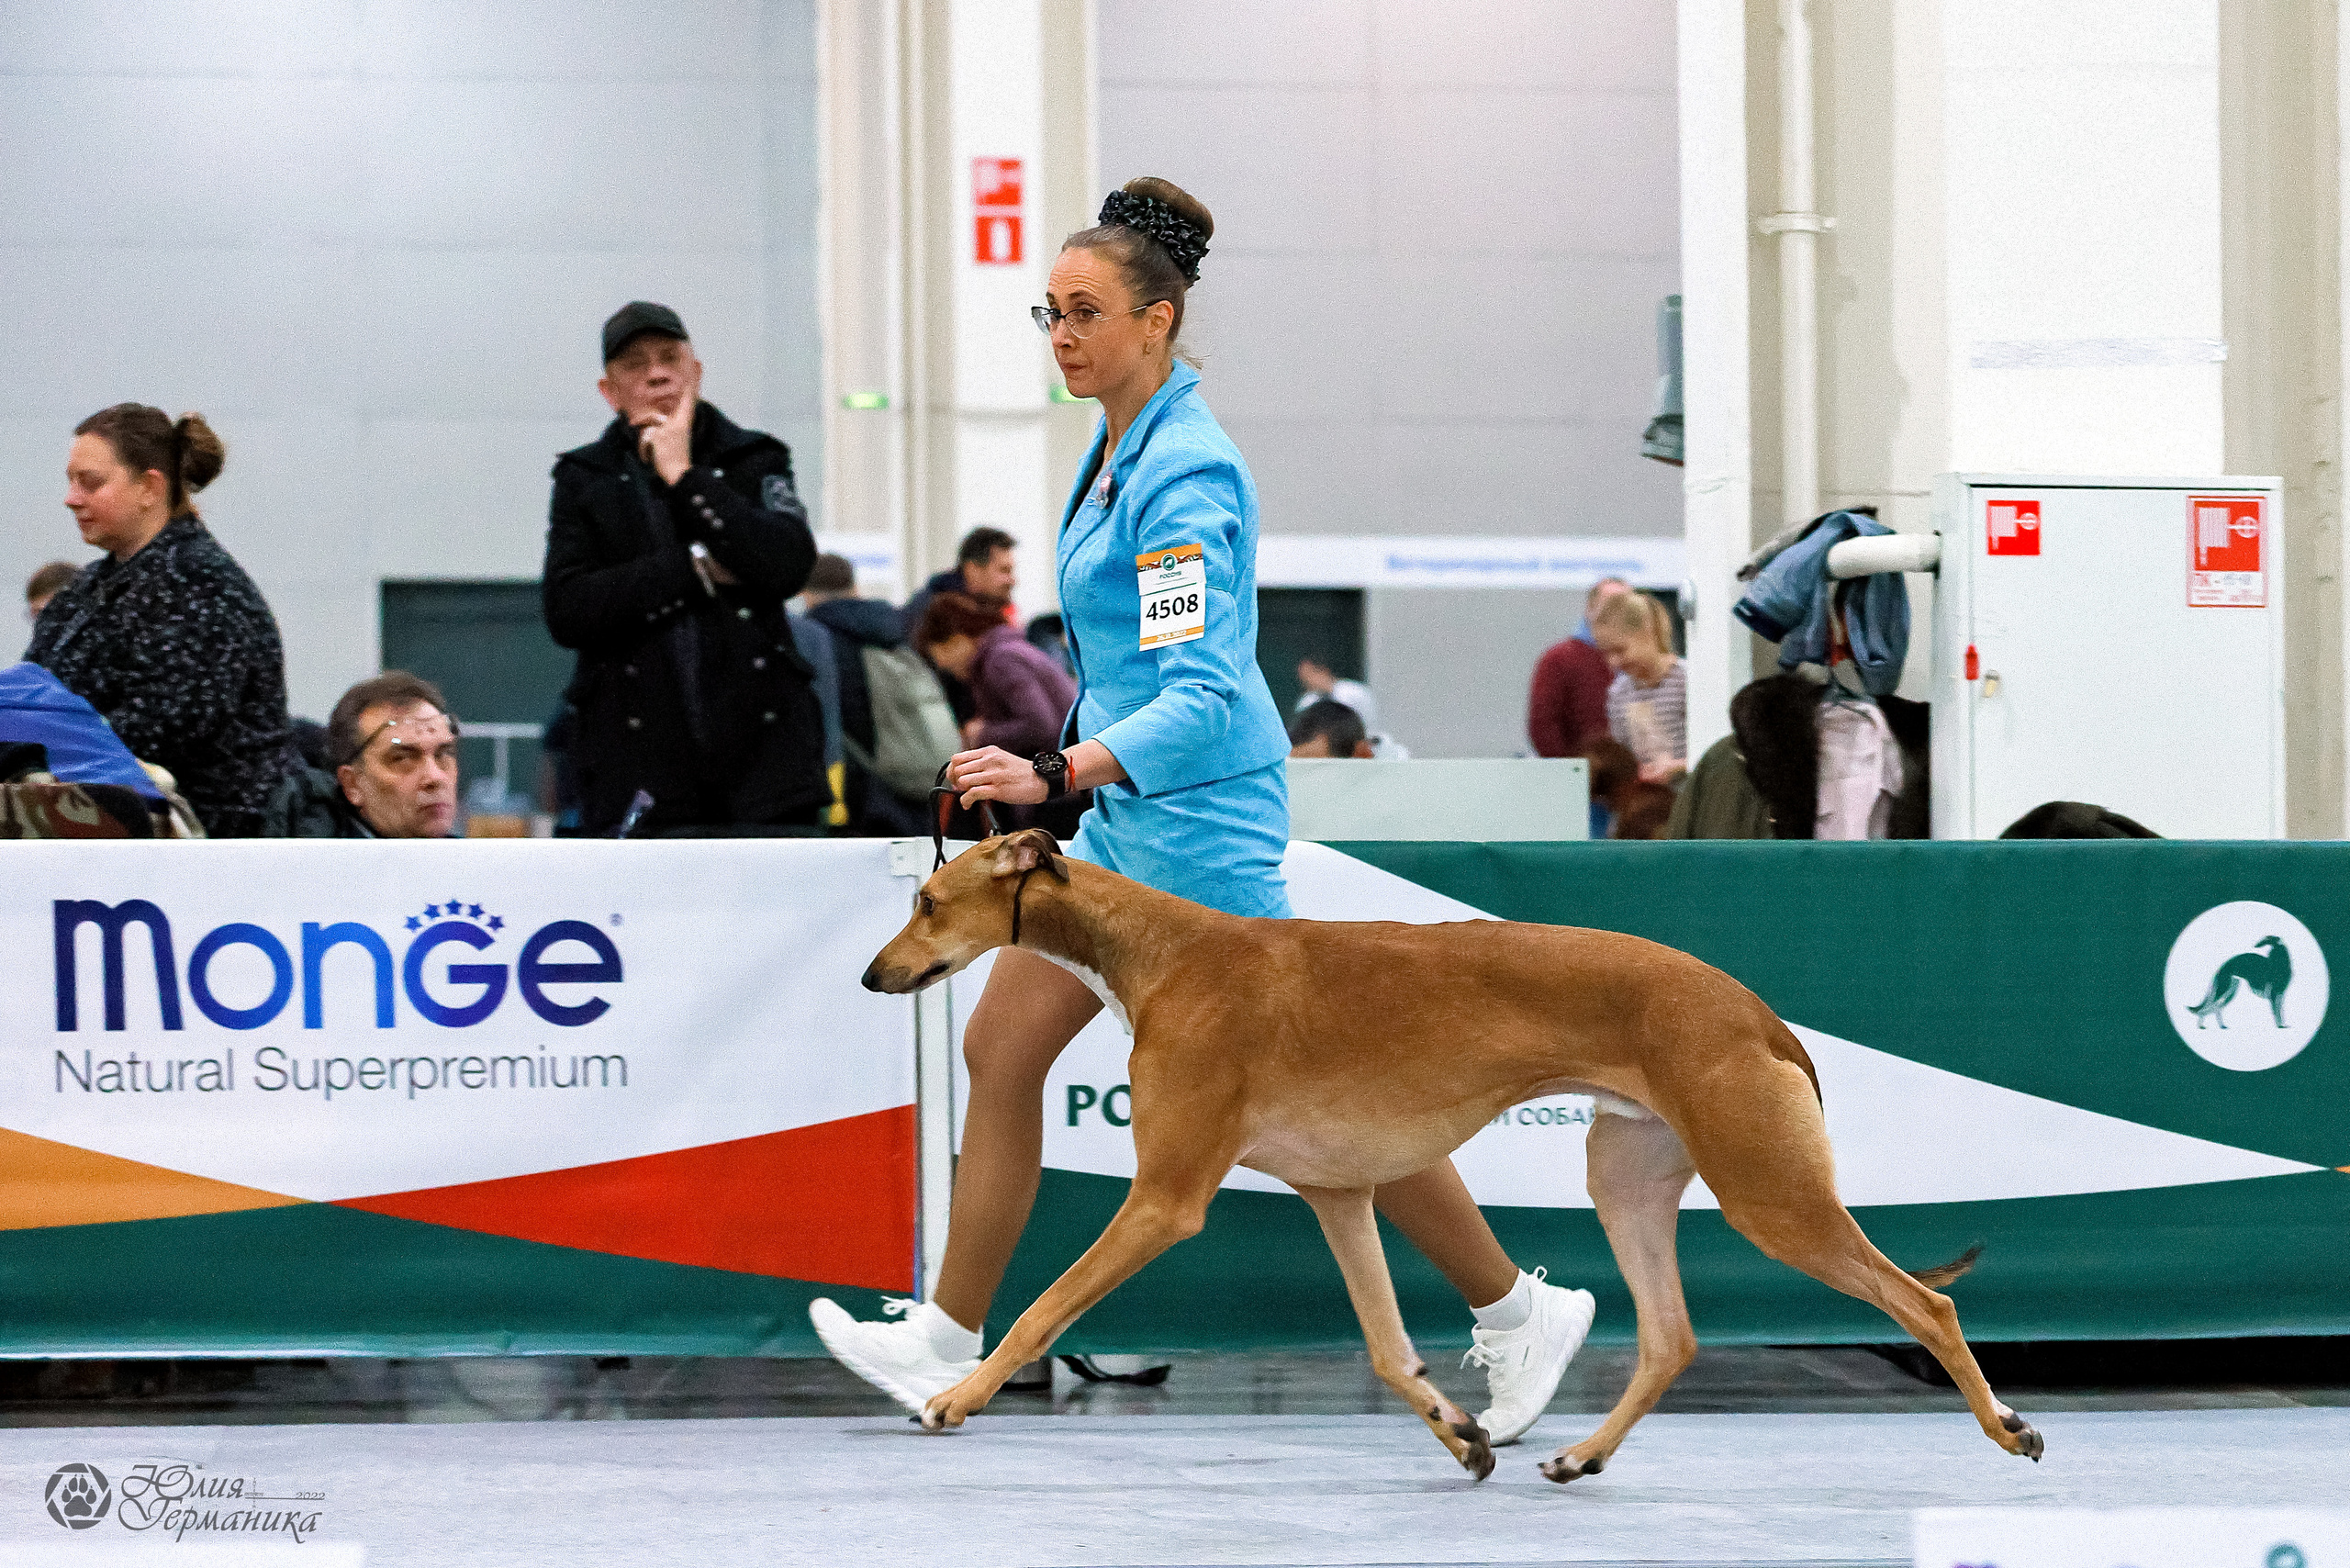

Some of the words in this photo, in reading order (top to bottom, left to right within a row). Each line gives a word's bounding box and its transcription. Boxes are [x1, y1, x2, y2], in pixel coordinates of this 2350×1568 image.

[1146, 593, 1199, 621] 4508
[55, 1047, 234, 1093] Natural
[253, 1044, 629, 1101] Superpremium
